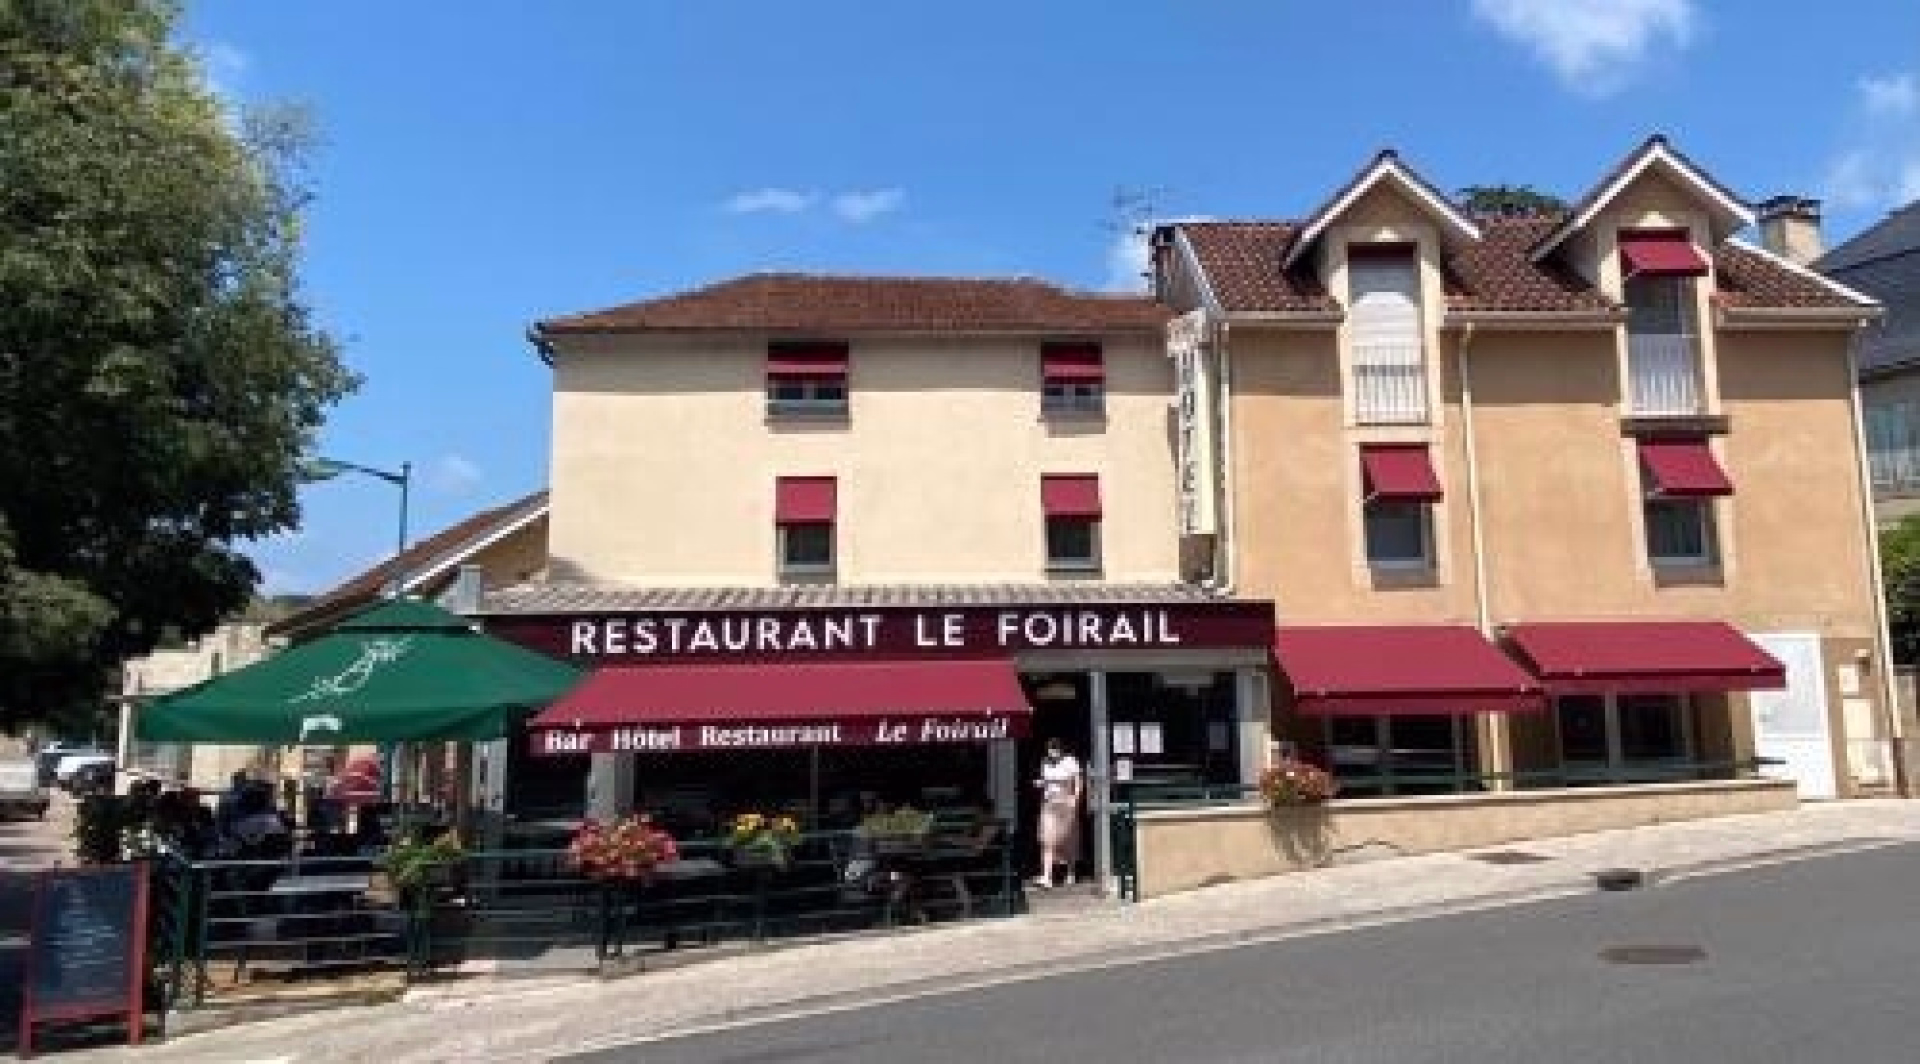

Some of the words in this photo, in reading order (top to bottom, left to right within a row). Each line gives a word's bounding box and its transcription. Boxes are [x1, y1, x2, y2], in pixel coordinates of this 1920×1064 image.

[571, 615, 880, 654] RESTAURANT
[915, 614, 965, 646] LE
[997, 611, 1180, 646] FOIRAIL
[545, 729, 592, 751] Bar
[700, 725, 841, 746] Restaurant
[875, 717, 907, 742] Le
[920, 716, 1009, 742] Foirail
